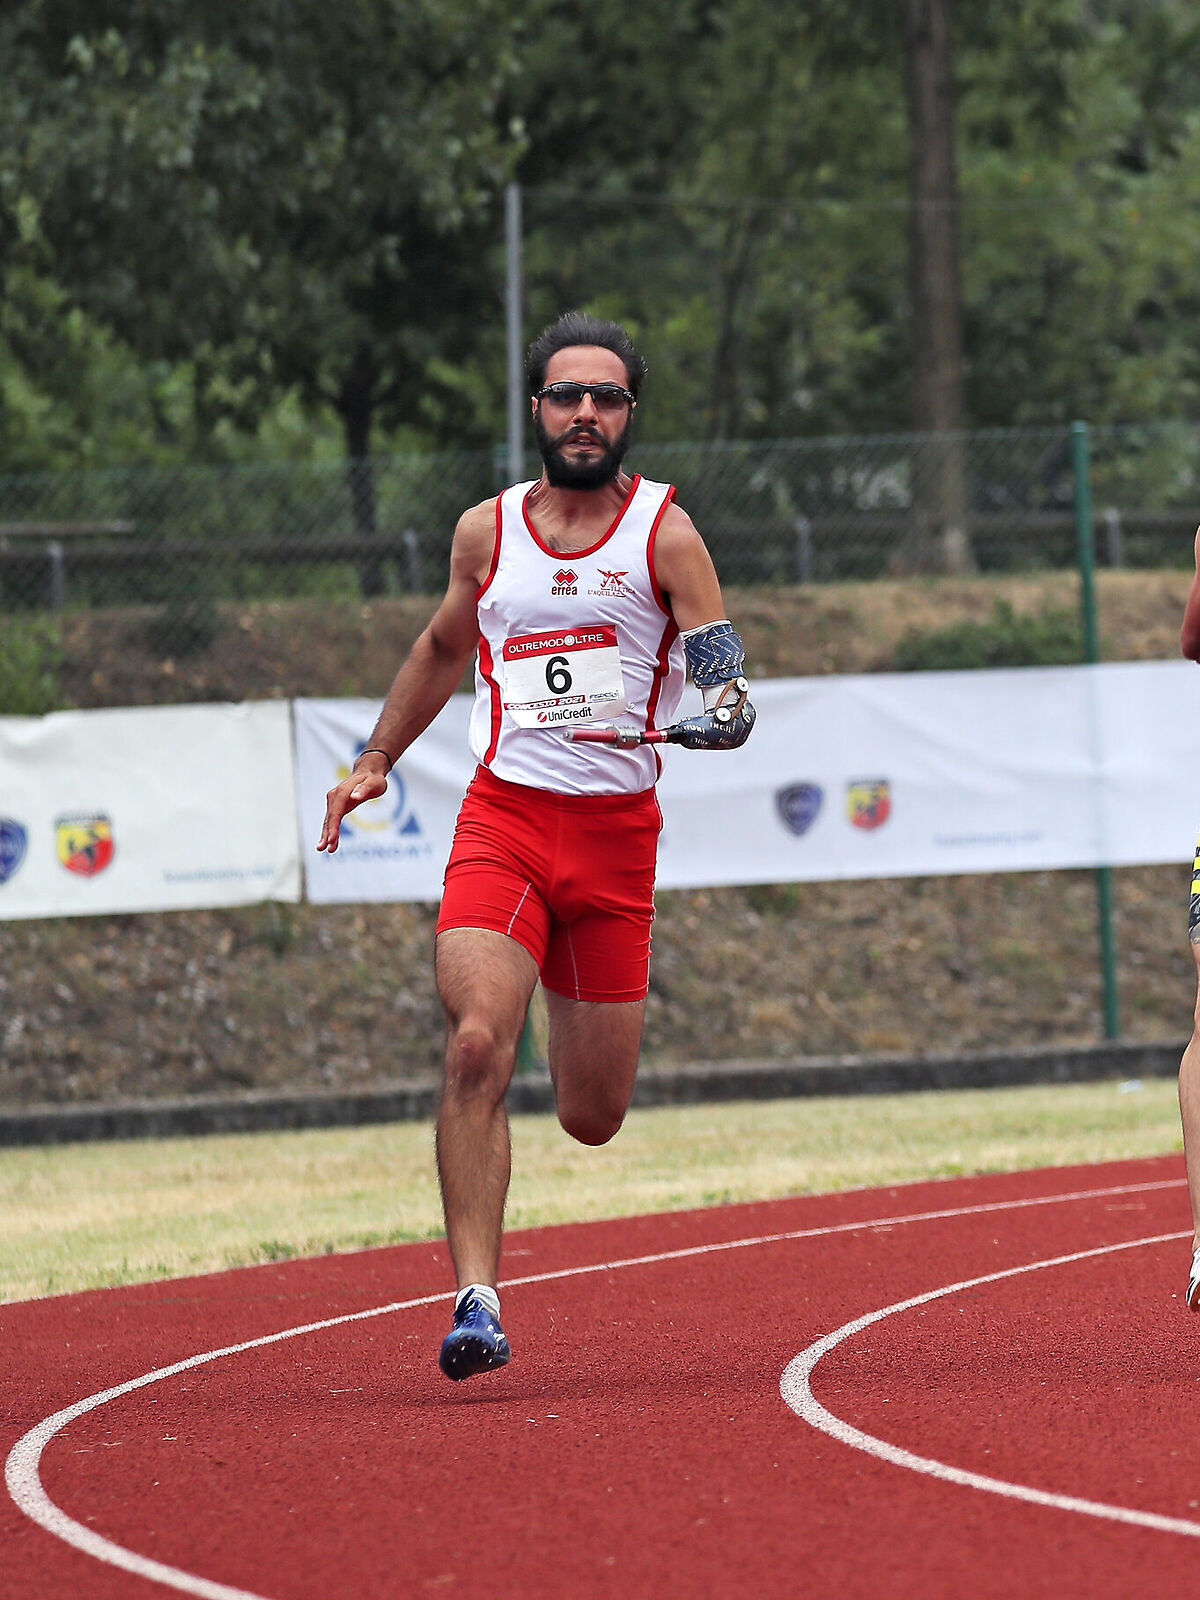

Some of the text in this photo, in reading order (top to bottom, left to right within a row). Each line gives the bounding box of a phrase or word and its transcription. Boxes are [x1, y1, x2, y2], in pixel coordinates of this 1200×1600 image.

[508, 633, 605, 654] OLTREMODOLTRE
[545, 656, 573, 695] 6
[558, 695, 585, 705] 2021
[548, 706, 592, 722] UniCredit
